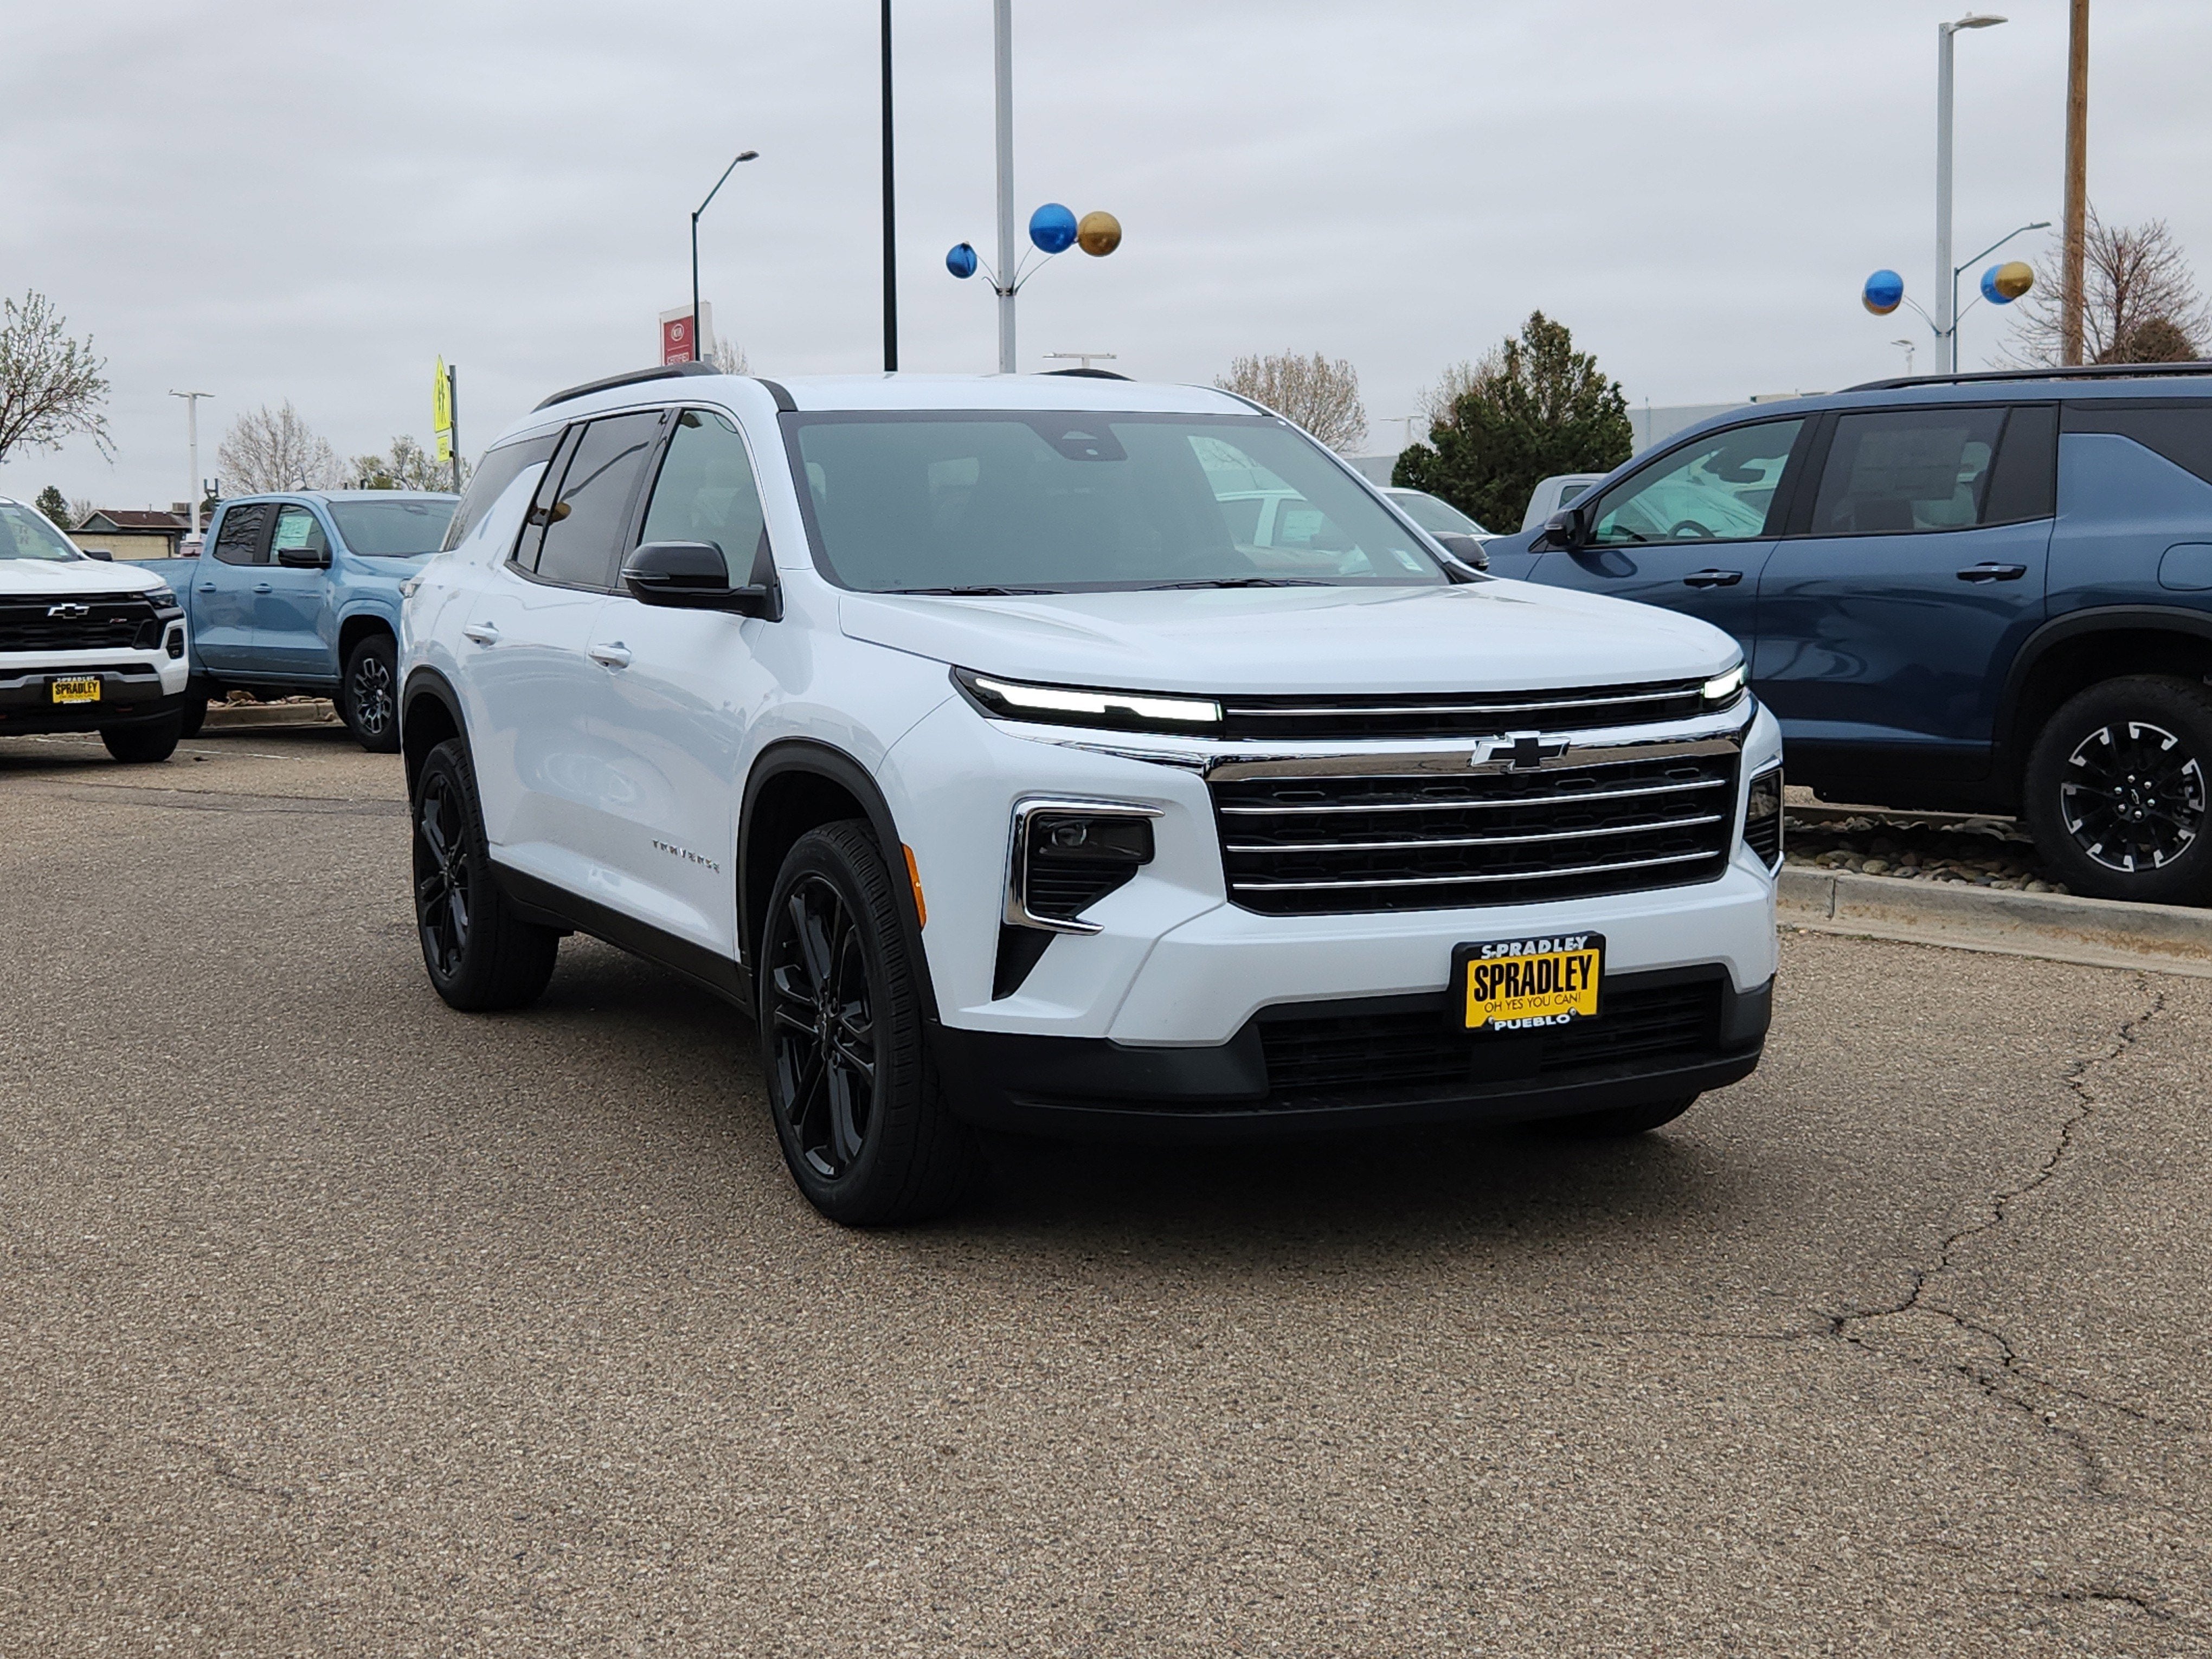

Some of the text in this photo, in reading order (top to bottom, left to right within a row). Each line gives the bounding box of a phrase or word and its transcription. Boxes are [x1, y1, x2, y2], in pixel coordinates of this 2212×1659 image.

[55, 682, 98, 695] SPRADLEY
[1481, 936, 1588, 960] SPRADLEY
[1474, 954, 1593, 1002] SPRADLEY
[1484, 993, 1581, 1013] OH YES YOU CAN!
[1494, 1014, 1571, 1031] PUEBLO
